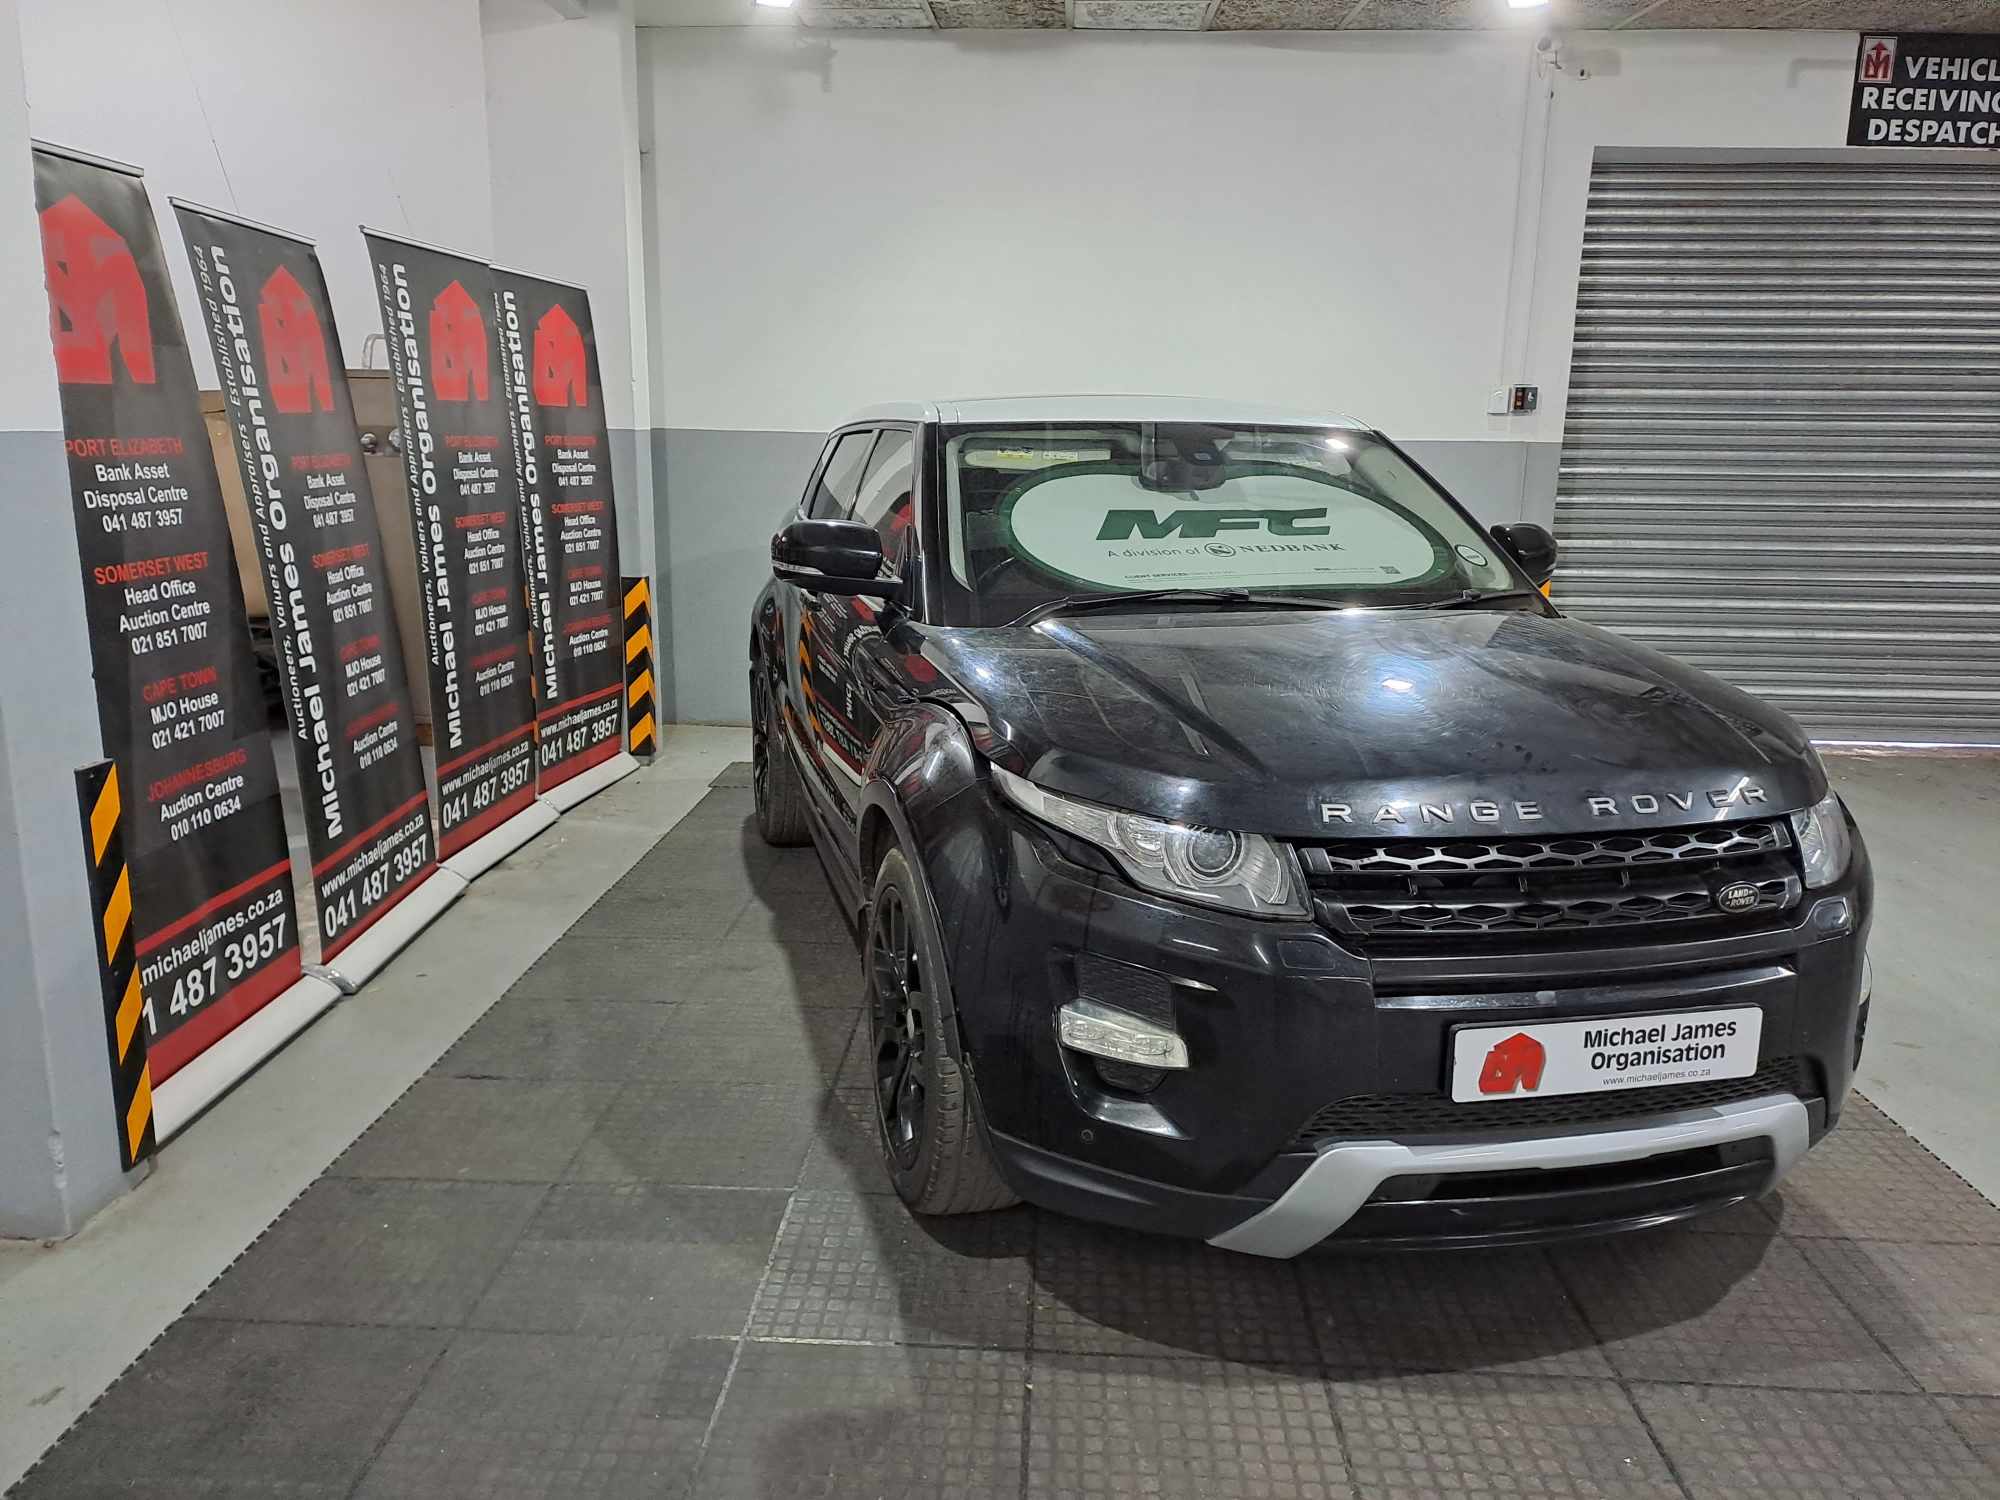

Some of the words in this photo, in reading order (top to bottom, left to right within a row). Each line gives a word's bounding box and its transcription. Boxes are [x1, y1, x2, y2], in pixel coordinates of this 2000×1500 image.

[1905, 56, 2000, 82] VEHICL
[1867, 118, 2000, 145] DESPATCH
[193, 244, 213, 293] 1964
[206, 297, 241, 407] Established
[211, 245, 287, 530] Organisation
[392, 263, 437, 495] Organisation
[503, 291, 538, 485] Organisation
[64, 439, 106, 457] PORT
[402, 406, 419, 485] Appraisers
[95, 463, 131, 482] Bank
[134, 462, 170, 480] Asset
[238, 423, 265, 520] Appraisers
[306, 474, 326, 489] Bank
[83, 487, 145, 510] Disposal
[148, 485, 188, 503] Centre
[303, 493, 334, 510] Disposal
[334, 491, 357, 505] Centre
[411, 488, 423, 516] and
[102, 514, 128, 533] 041
[131, 511, 152, 529] 487
[155, 508, 183, 527] 3957
[313, 514, 325, 529] 041
[1096, 507, 1330, 540] MFC
[258, 524, 274, 558] and
[416, 520, 430, 573] Valuers
[529, 493, 549, 584] James
[1107, 549, 1120, 558] A
[1124, 546, 1181, 558] division
[1184, 546, 1201, 556] of
[1239, 543, 1346, 553] NEDBANK
[94, 556, 171, 585] SOMERSET
[175, 551, 209, 571] WEST
[326, 568, 344, 585] Head
[344, 564, 365, 579] Office
[428, 504, 451, 612] James
[124, 581, 157, 606] Head
[160, 580, 196, 599] Office
[268, 563, 287, 628] Valuers
[280, 542, 316, 673] James
[326, 587, 351, 606] Auction
[351, 583, 373, 598] Centre
[119, 610, 169, 633] Auction
[171, 601, 211, 621] Centre
[332, 606, 345, 623] 021
[132, 634, 154, 655] 021
[156, 627, 178, 649] 851
[181, 621, 208, 642] 7007
[538, 592, 558, 699] Michael
[360, 654, 382, 671] House
[143, 678, 177, 703] CAPE
[182, 665, 218, 690] TOWN
[283, 634, 308, 740] Auctioneers,
[439, 621, 462, 749] Michael
[151, 702, 177, 725] MJO
[179, 692, 219, 715] House
[152, 730, 171, 749] 021
[174, 720, 195, 741] 421
[198, 709, 225, 732] 7007
[353, 731, 378, 754] Auction
[541, 737, 563, 767] 041
[566, 726, 587, 752] 487
[592, 713, 619, 743] 3957
[303, 684, 343, 840] Michael
[161, 791, 202, 822] Auction
[205, 775, 244, 800] Centre
[442, 792, 468, 829] 041
[472, 777, 497, 810] 487
[500, 758, 530, 794] 3957
[1320, 800, 1544, 825] RANGE
[1587, 786, 1769, 817] ROVER
[171, 821, 189, 841] 010
[191, 809, 211, 829] 110
[214, 795, 241, 820] 0634
[321, 813, 424, 898] www.michaeljames.co.za
[325, 888, 357, 938] 041
[362, 862, 390, 907] 487
[394, 833, 428, 883] 3957
[1728, 889, 1749, 899] LAND
[169, 956, 217, 1017] 487
[225, 912, 286, 980] 3957
[1584, 1024, 1666, 1049] Michael
[1671, 1021, 1737, 1042] James
[1591, 1043, 1726, 1071] Organisation
[1602, 1068, 1711, 1086] www.michaeljames.co.za
